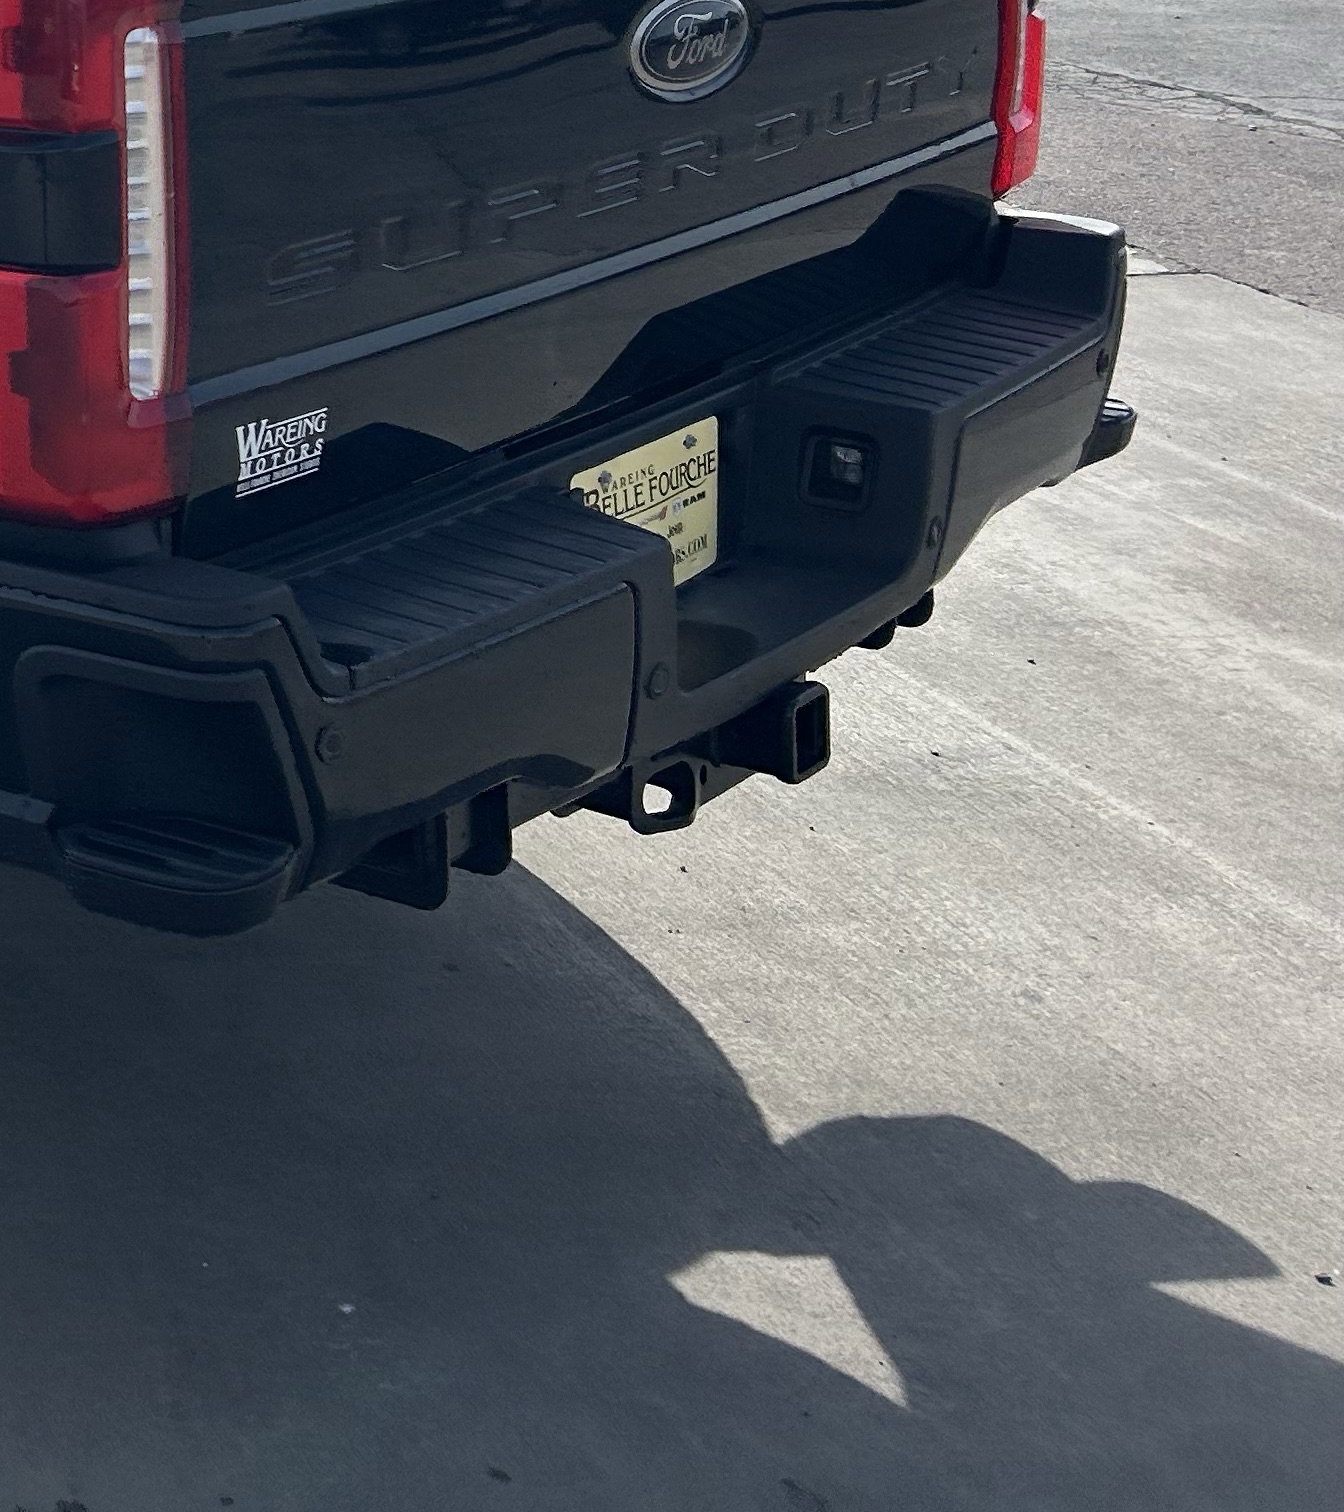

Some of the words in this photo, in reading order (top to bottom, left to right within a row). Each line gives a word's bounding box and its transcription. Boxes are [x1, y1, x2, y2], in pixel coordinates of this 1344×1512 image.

[667, 11, 729, 69] Ford
[263, 148, 726, 308] SUPER
[752, 44, 982, 164] DUTY
[235, 412, 327, 463] WAREING
[237, 438, 324, 481] MOTORS
[649, 450, 717, 503] FOURCHE
[682, 491, 706, 508] RAM
